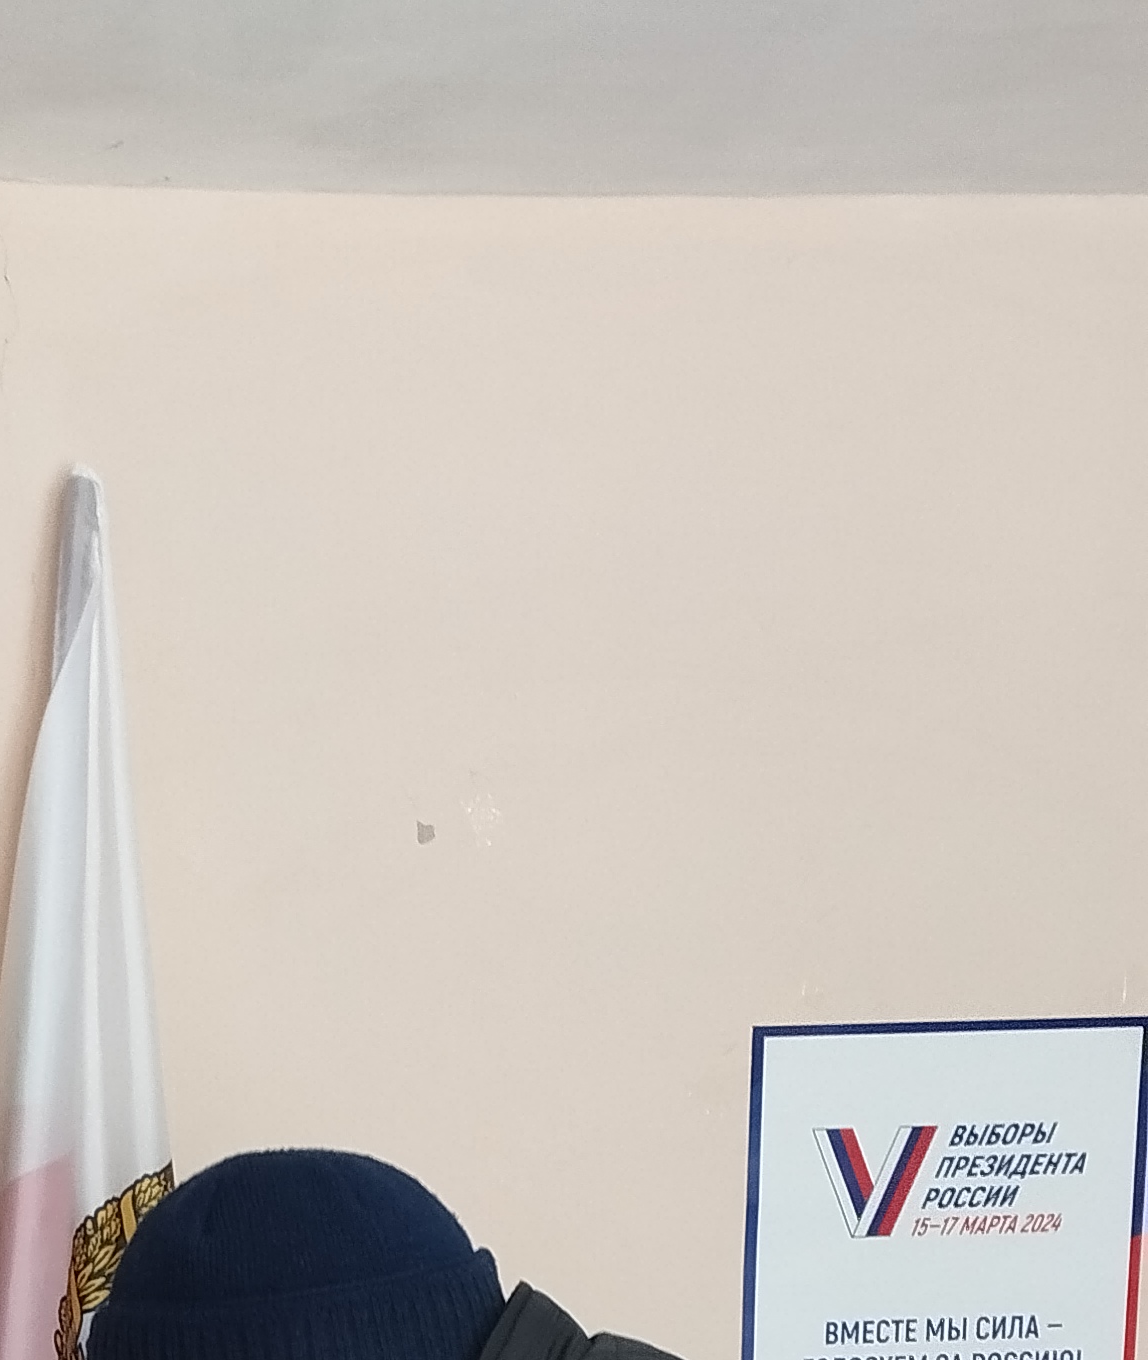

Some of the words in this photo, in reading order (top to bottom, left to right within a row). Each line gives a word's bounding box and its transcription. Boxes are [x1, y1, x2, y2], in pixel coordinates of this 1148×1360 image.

[948, 1122, 1058, 1147] ВЫБОРЫ
[935, 1152, 1087, 1180] ПРЕЗИДЕНТА
[922, 1186, 1020, 1210] РОССИИ
[959, 1216, 1020, 1237] МАРТА
[1021, 1214, 1063, 1234] 2024
[825, 1319, 917, 1345] ВМЕСТЕ
[926, 1317, 967, 1341] МЫ
[975, 1315, 1040, 1340] СИЛА
